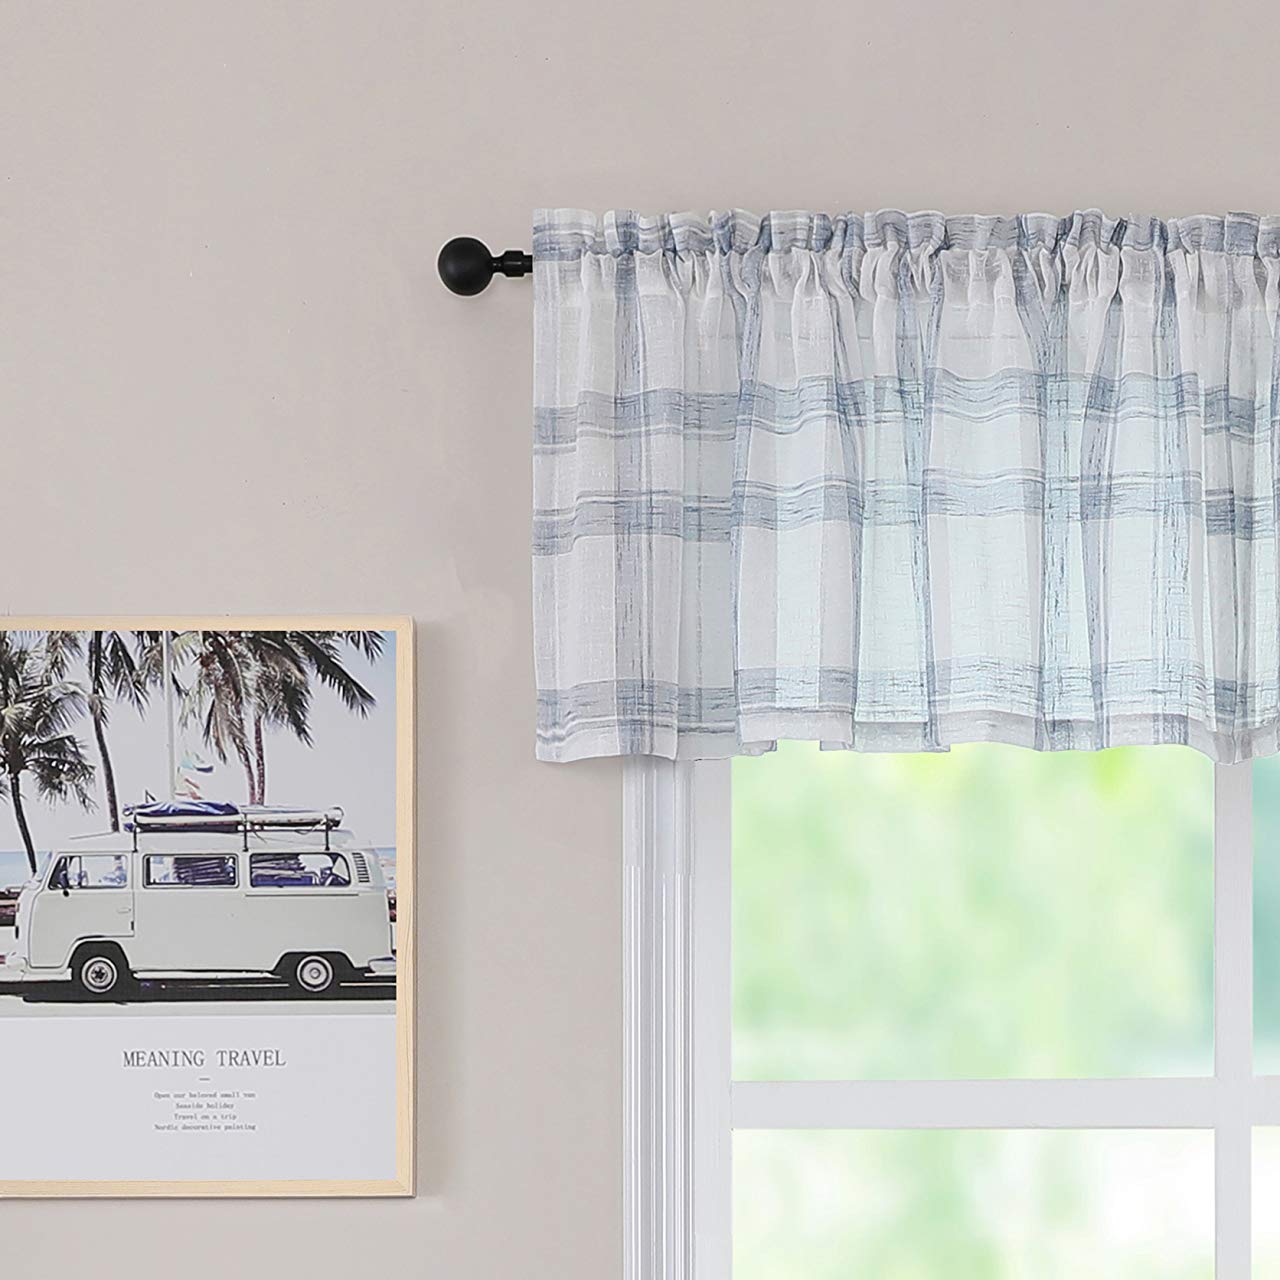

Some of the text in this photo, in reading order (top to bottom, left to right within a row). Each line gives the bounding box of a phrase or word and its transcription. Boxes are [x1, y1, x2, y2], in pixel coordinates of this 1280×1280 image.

[122, 1048, 287, 1068] MEANING TRAVEL
[188, 1091, 218, 1099] beloved
[206, 1102, 235, 1110] holiday
[173, 1113, 198, 1121] Travel
[220, 1113, 237, 1121] trip
[154, 1123, 257, 1131] Nordic decorative painting
